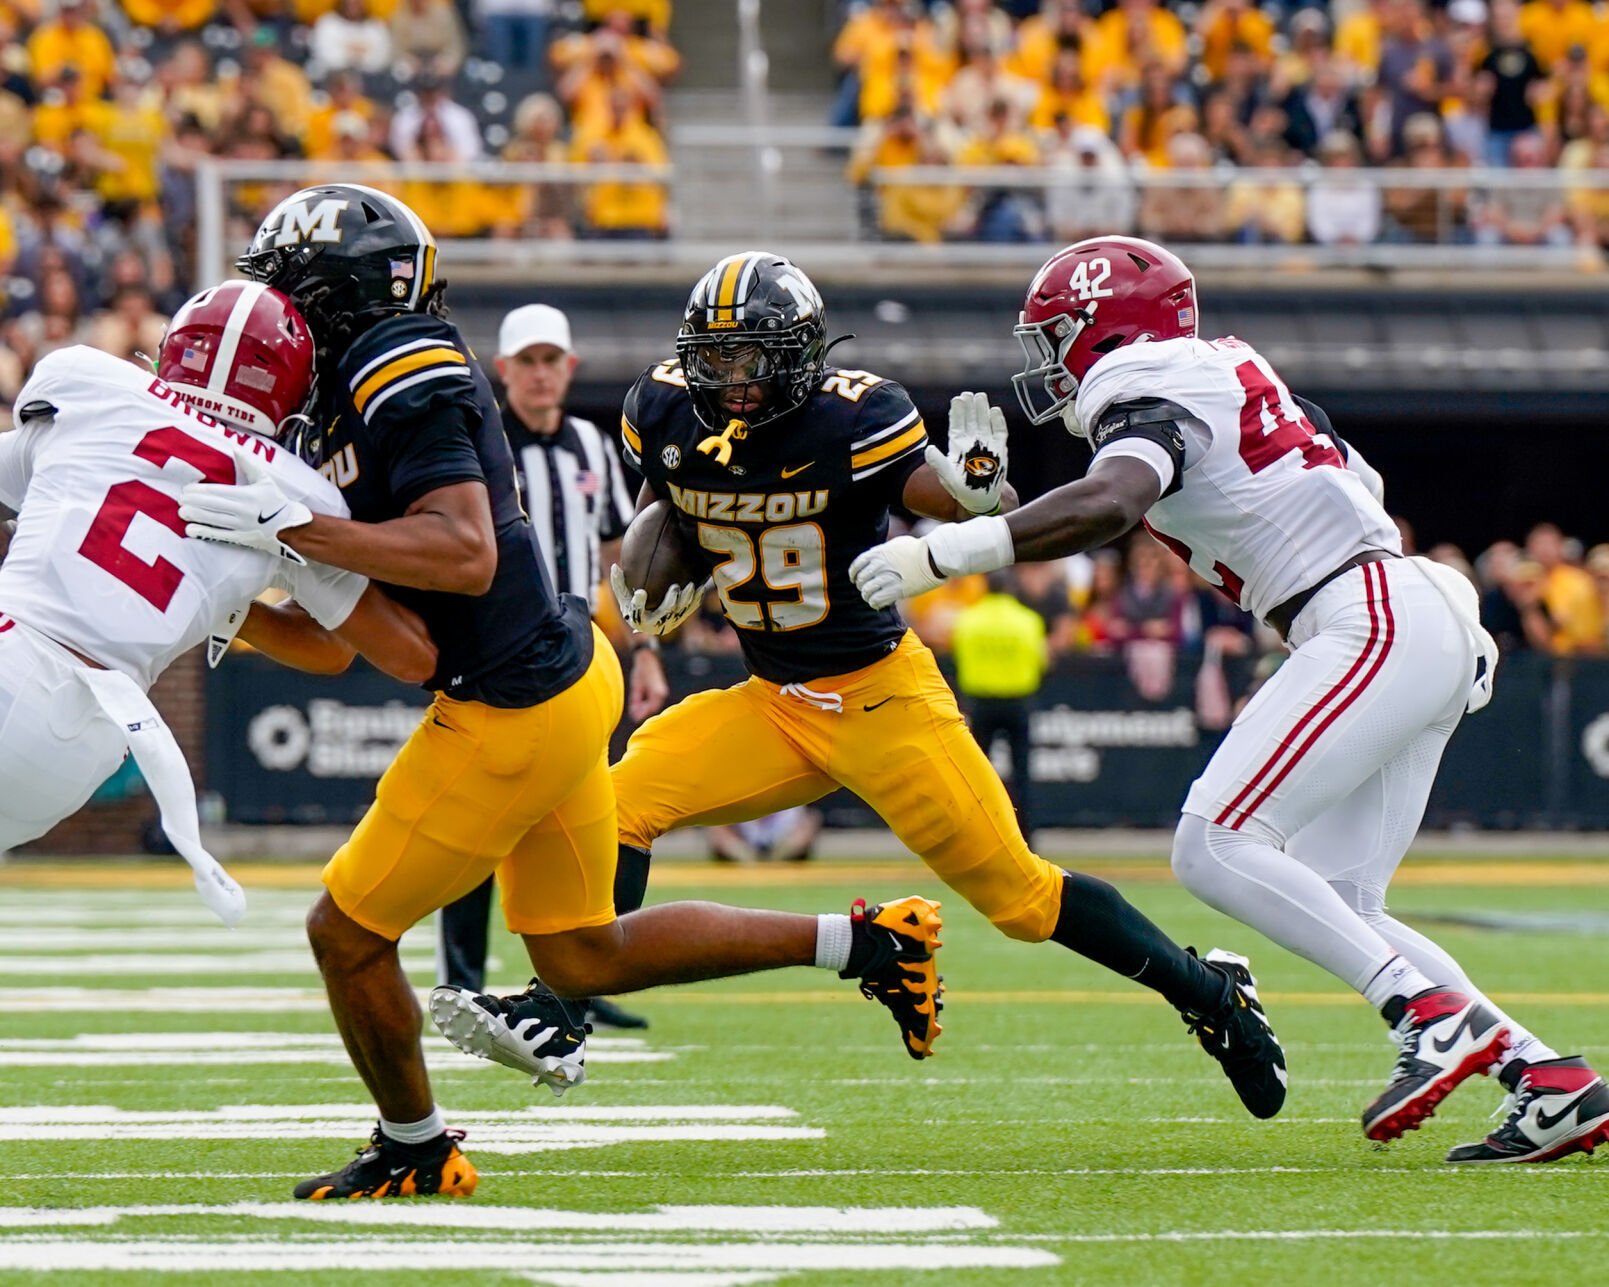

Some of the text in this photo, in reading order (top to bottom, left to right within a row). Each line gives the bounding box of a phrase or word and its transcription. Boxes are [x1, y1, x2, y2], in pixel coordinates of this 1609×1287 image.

[274, 199, 350, 248] M
[1069, 257, 1114, 301] 42
[227, 405, 256, 424] TIDE
[662, 444, 682, 470] SEC
[666, 480, 830, 523] MIZZOU
[697, 521, 832, 632] 29
